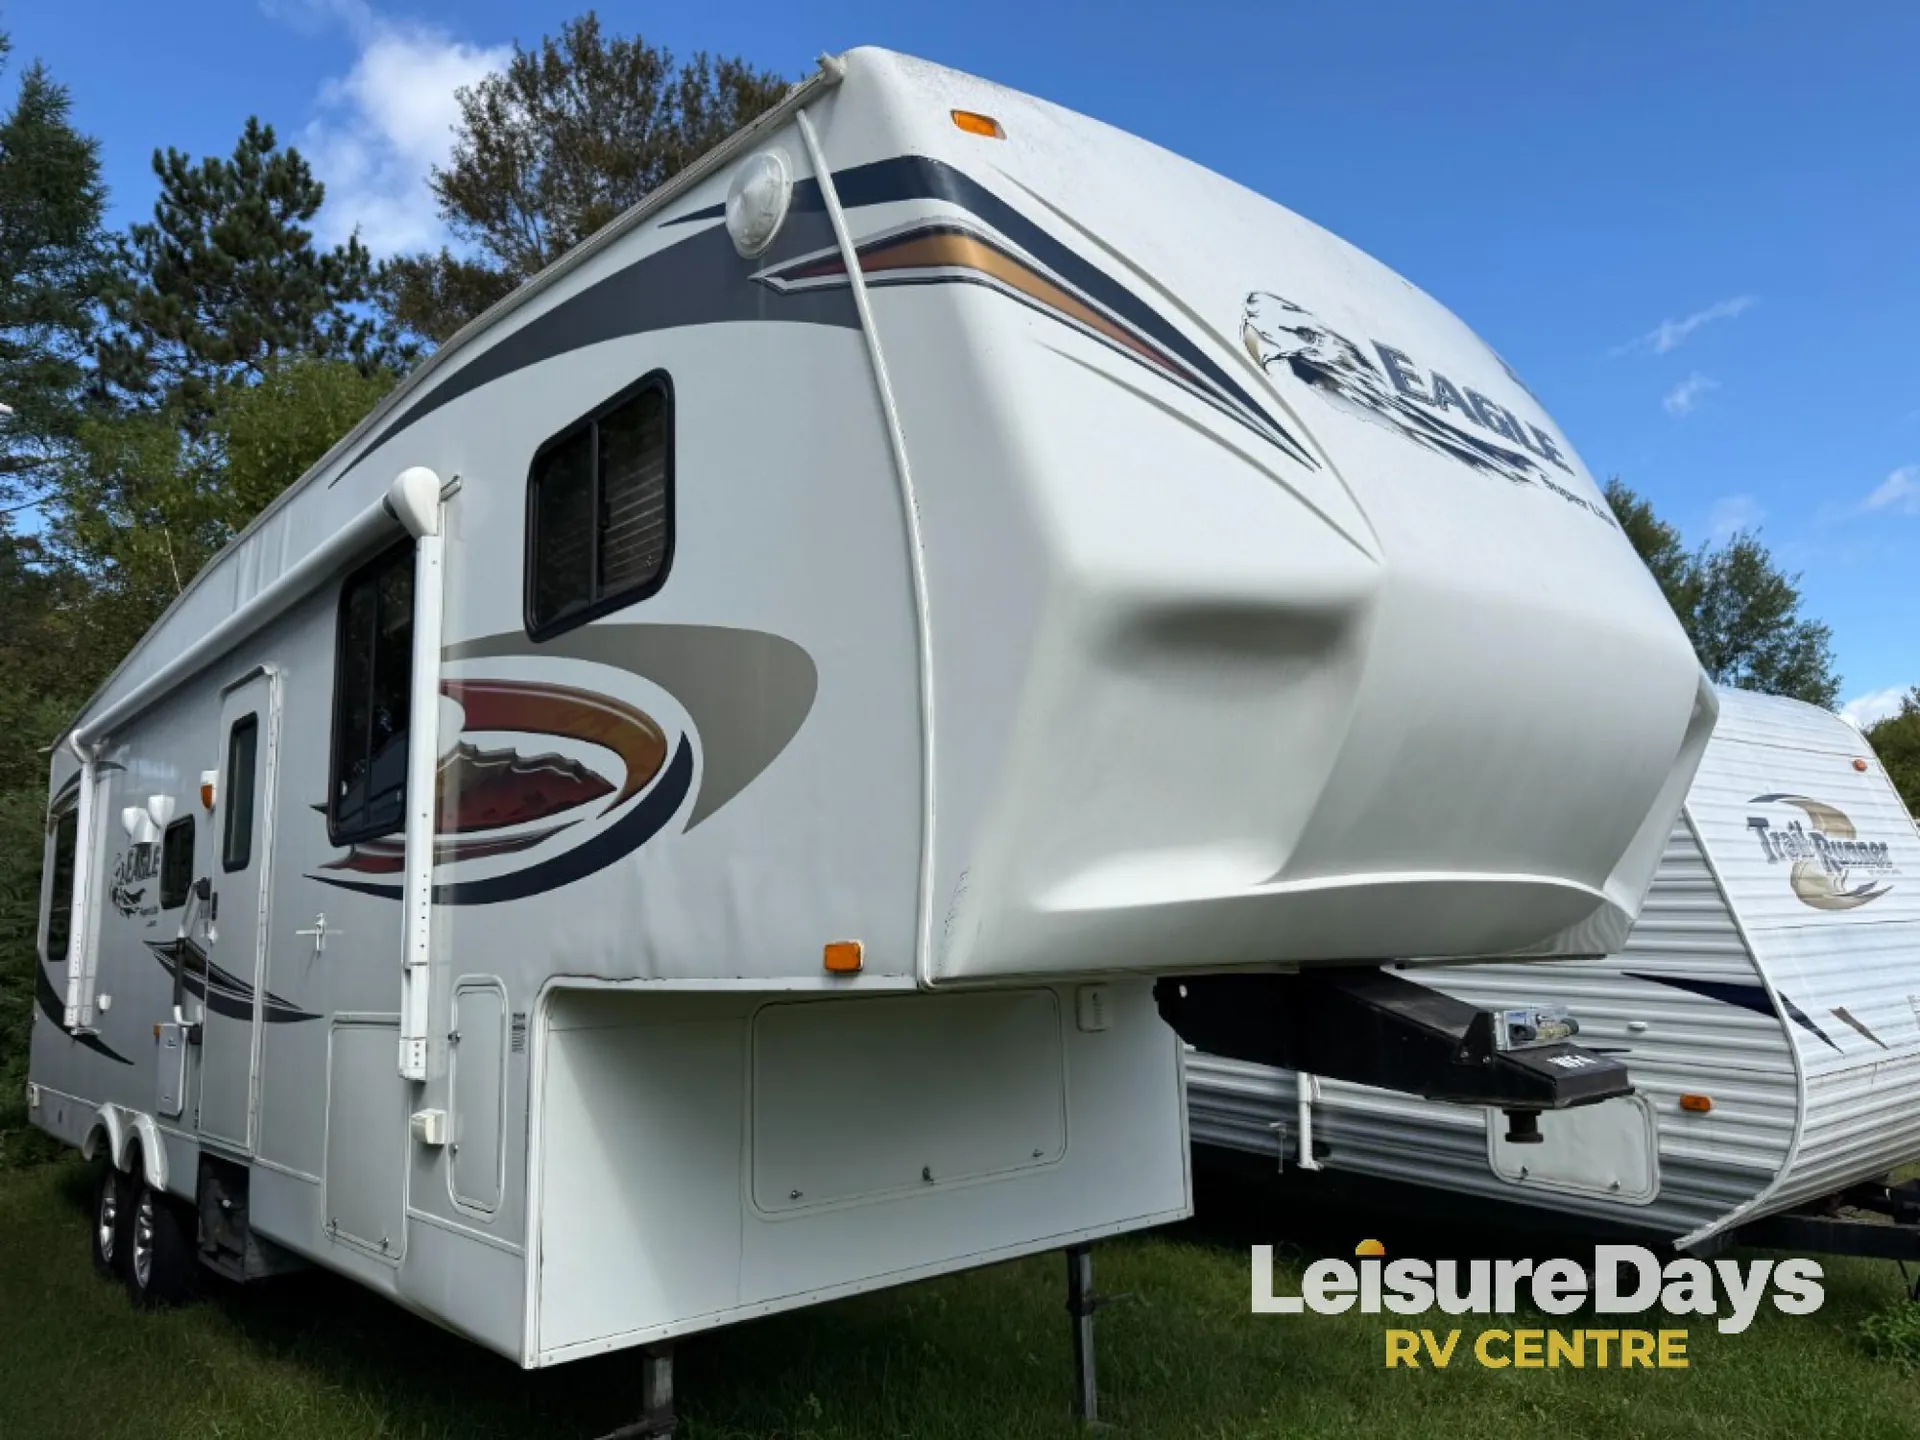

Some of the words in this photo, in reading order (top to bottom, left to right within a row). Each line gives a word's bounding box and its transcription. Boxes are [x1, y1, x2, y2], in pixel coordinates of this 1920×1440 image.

[1369, 338, 1575, 477] EAGLE
[1747, 816, 1816, 865] Trail
[1807, 831, 1891, 875] Runner
